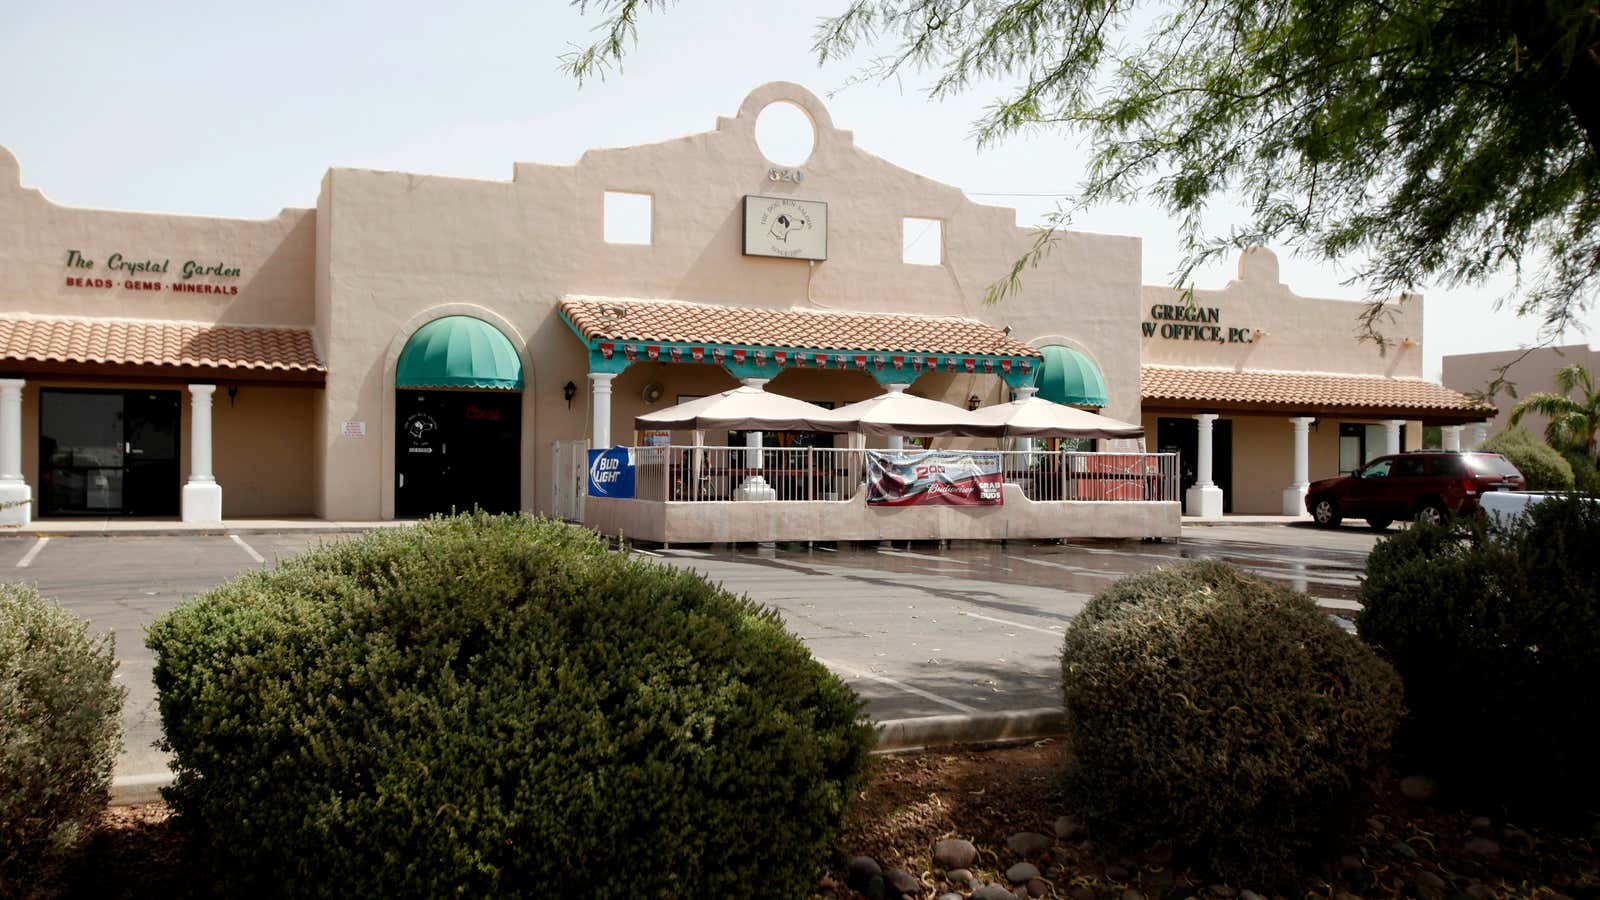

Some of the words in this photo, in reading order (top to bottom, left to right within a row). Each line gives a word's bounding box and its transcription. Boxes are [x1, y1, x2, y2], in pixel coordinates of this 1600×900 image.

[66, 250, 94, 269] The
[108, 253, 169, 276] Crystal
[183, 260, 241, 279] Garden
[66, 277, 113, 289] BEADS
[124, 280, 162, 291] GEMS
[173, 282, 238, 295] MINERALS
[1151, 304, 1220, 323] GREGAN
[1161, 324, 1225, 344] OFFICE,
[600, 458, 619, 471] BUD
[595, 471, 621, 483] LIGHT
